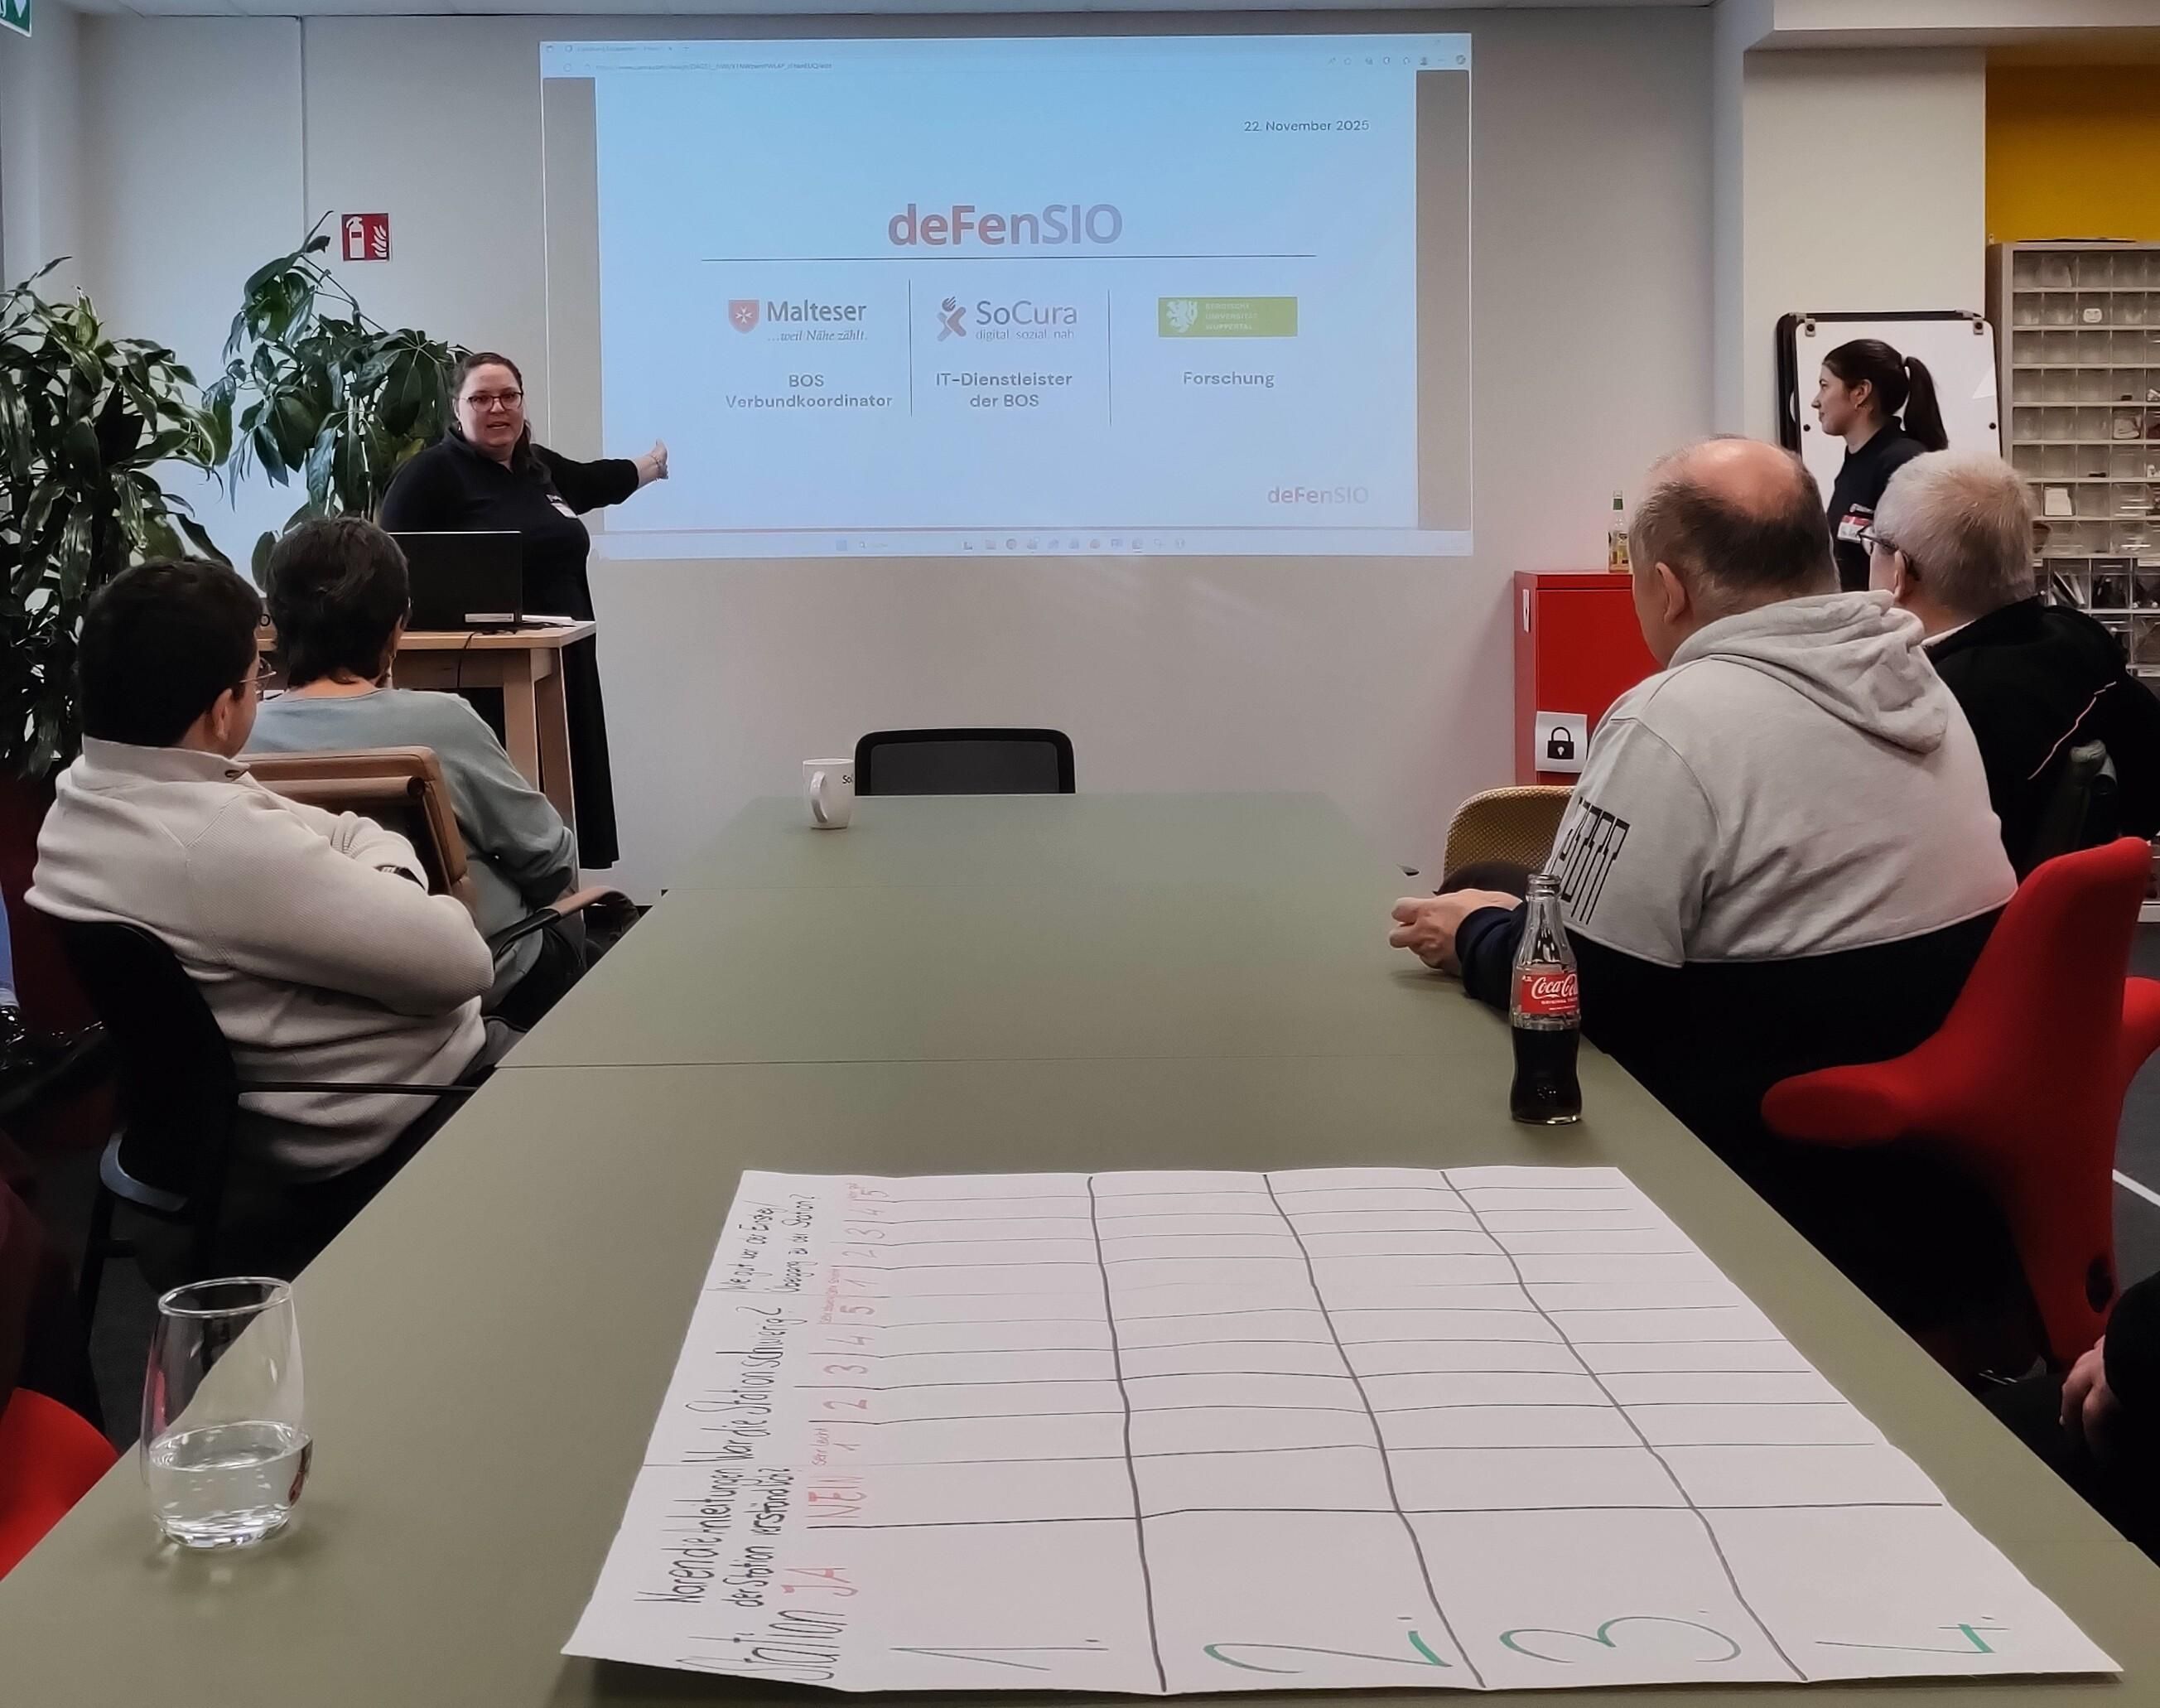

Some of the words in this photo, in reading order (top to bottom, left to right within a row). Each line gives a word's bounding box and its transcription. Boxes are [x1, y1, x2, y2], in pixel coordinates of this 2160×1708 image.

[1244, 120, 1262, 132] 22.
[1266, 119, 1332, 132] November
[1336, 119, 1370, 131] 2025
[888, 203, 1123, 246] deFenSIO
[767, 299, 867, 322] Malteser
[976, 300, 1078, 326] SoCura
[806, 330, 835, 341] Nähe
[788, 374, 824, 388] BOS
[936, 372, 1073, 387] IT-Dienstleister
[1183, 371, 1275, 388] Forschung
[726, 393, 893, 409] Verbundkoordinator
[970, 394, 998, 408] der
[1004, 393, 1039, 408] BOS
[1267, 485, 1370, 504] deFenSIO
[842, 774, 853, 784] So
[844, 1228, 885, 1239] 3
[840, 1305, 875, 1315] 5
[826, 1336, 875, 1346] 4
[822, 1365, 868, 1374] 3
[685, 1372, 774, 1415] Station
[822, 1399, 867, 1410] 2
[700, 1420, 771, 1437] die
[680, 1440, 755, 1463] War
[805, 1477, 867, 1518] NEIN
[659, 1537, 722, 1557] die
[722, 1546, 774, 1586] Station
[780, 1566, 858, 1596] JA
[721, 1589, 764, 1607] der
[676, 1610, 847, 1681] Station
